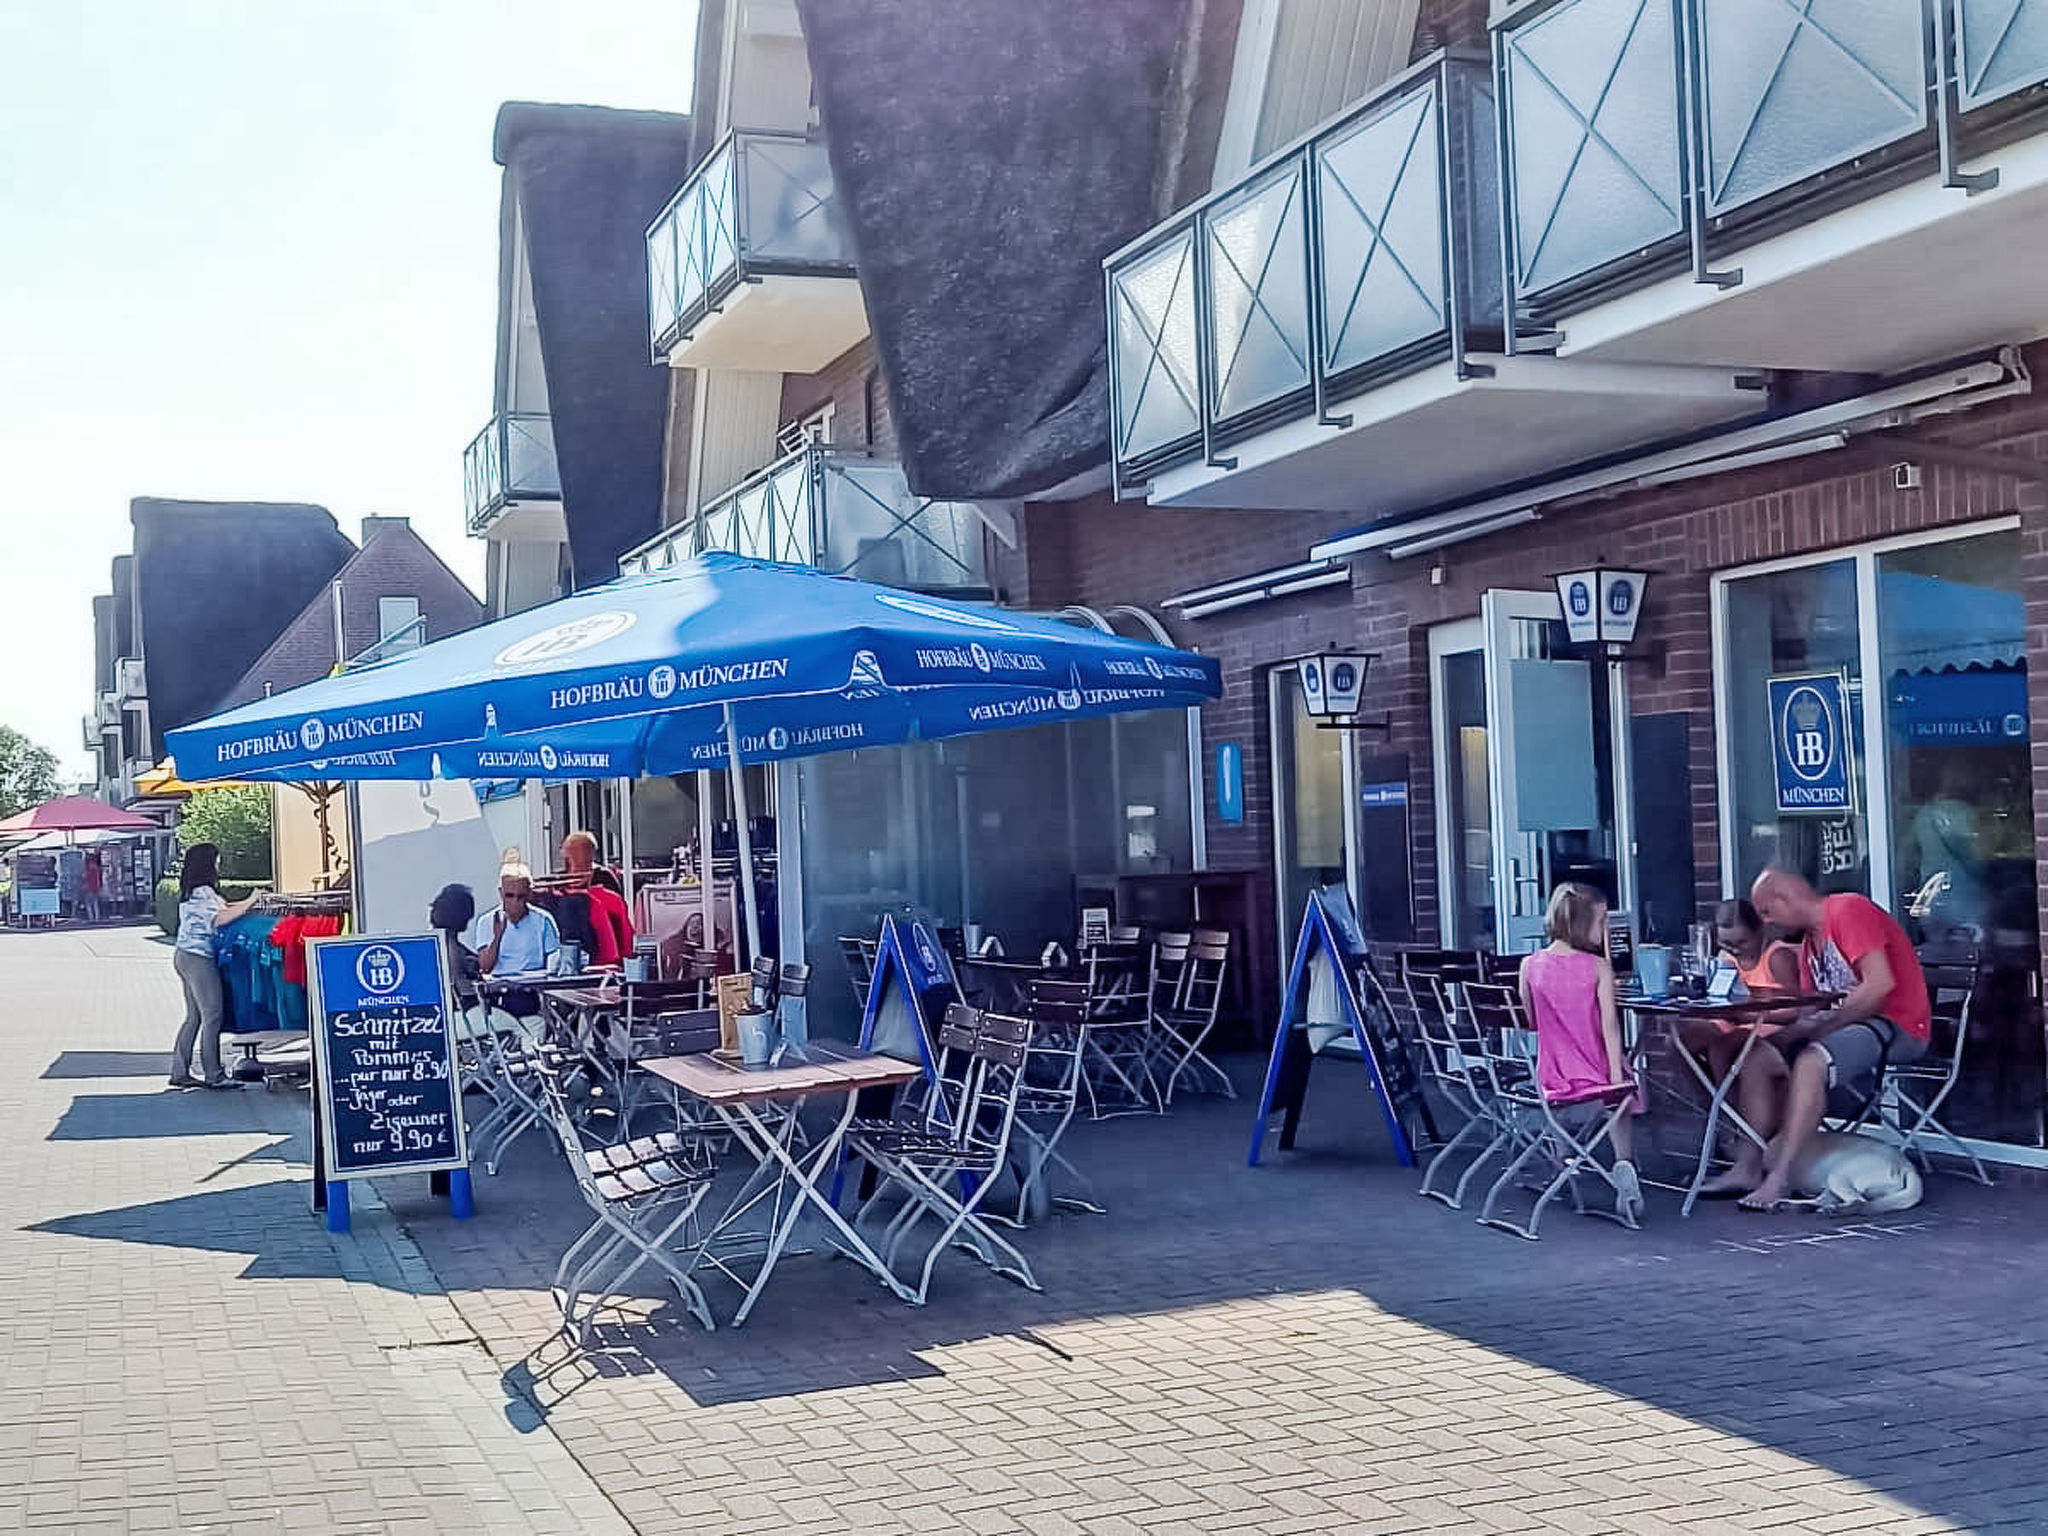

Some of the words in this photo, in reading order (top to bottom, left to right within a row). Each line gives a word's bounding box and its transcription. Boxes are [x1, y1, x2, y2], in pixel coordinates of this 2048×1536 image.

[551, 674, 644, 710] HOFBRÄU
[679, 658, 790, 691] MÜNCHEN
[217, 728, 299, 763] HOFBRÄU
[328, 711, 424, 744] MÜNCHEN
[1795, 731, 1825, 766] HB
[1782, 785, 1845, 804] MÜNCHEN
[370, 967, 394, 986] HB
[334, 1005, 443, 1037] Schnitzel
[368, 1036, 399, 1050] mit
[350, 1049, 433, 1066] Pommes
[381, 1069, 410, 1081] nur
[387, 1093, 424, 1107] oder
[370, 1109, 448, 1133] Zigeuner
[353, 1139, 386, 1153] nur
